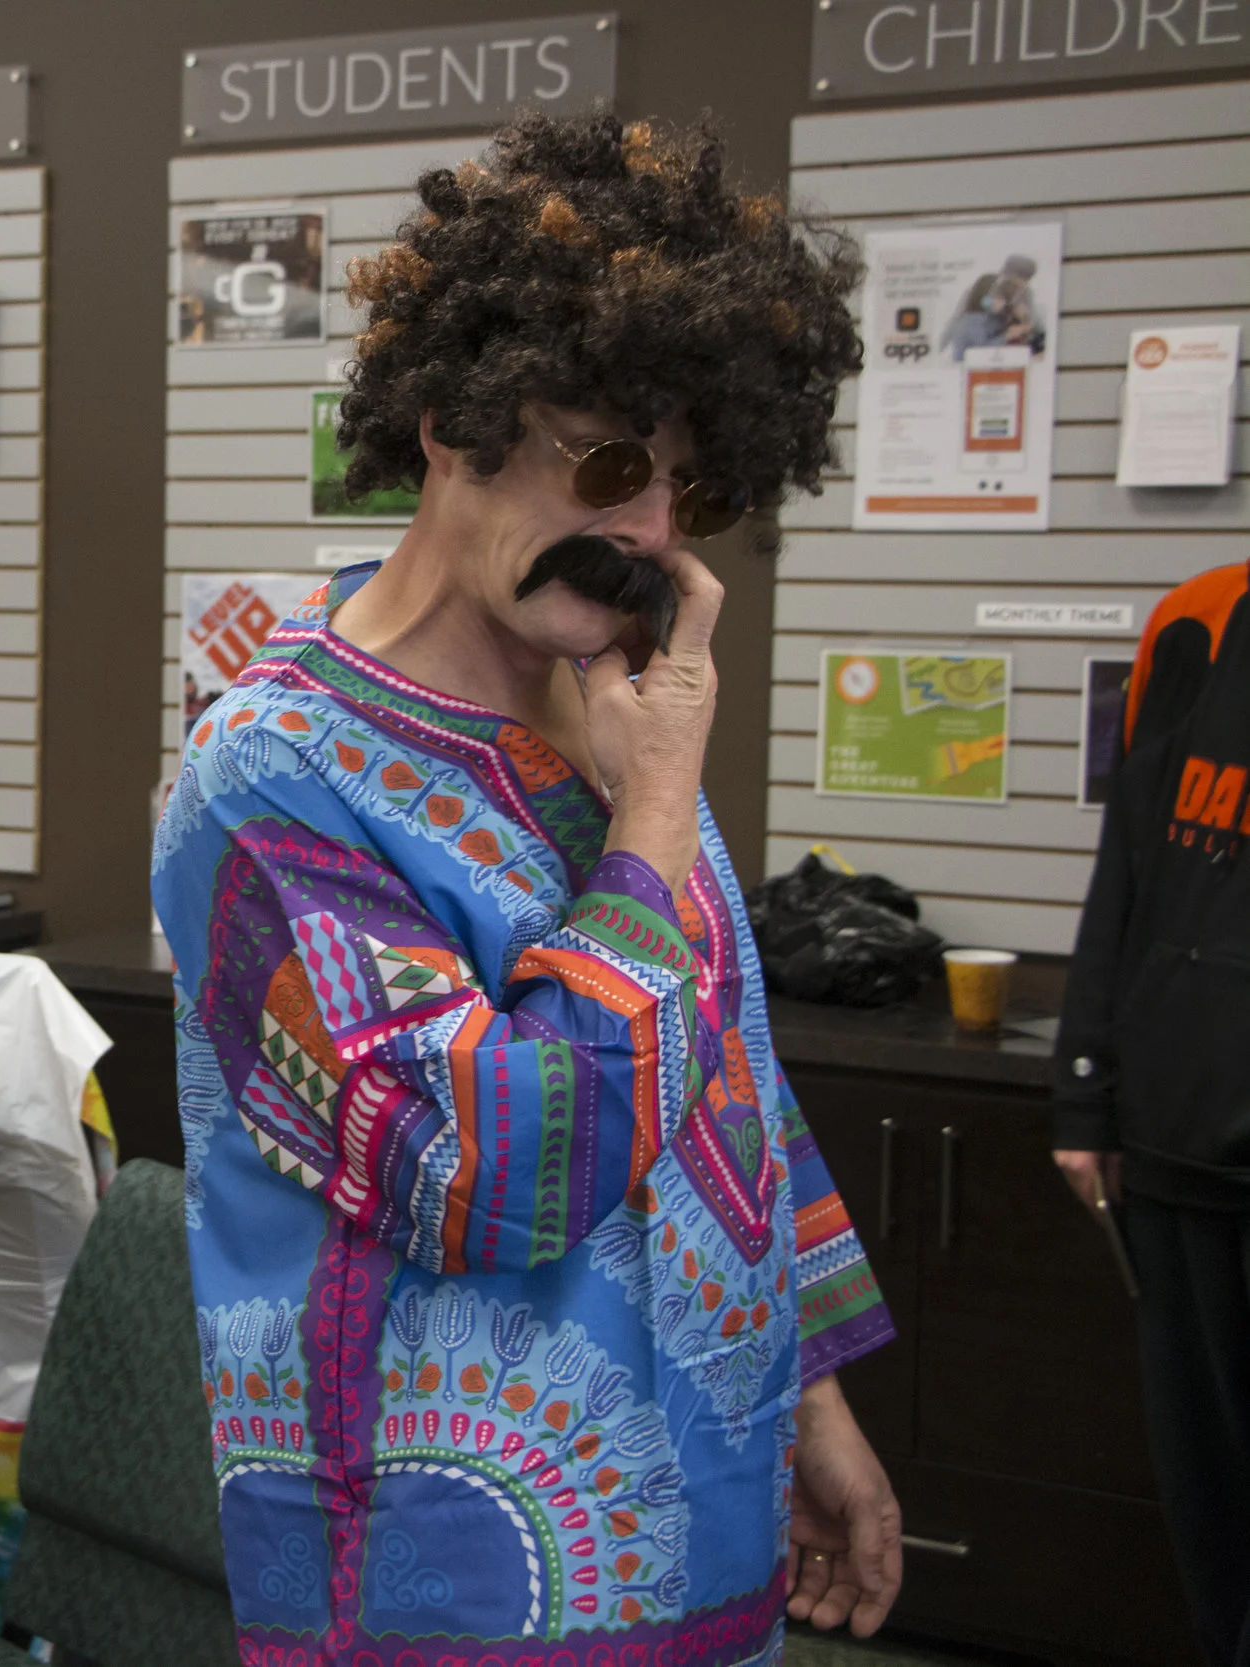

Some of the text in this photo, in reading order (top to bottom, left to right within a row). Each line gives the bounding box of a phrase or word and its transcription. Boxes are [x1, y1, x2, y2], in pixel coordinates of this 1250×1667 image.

[217, 35, 571, 123] STUDENTS
[883, 344, 930, 365] app
[188, 581, 254, 647] LEVEL
[206, 594, 277, 681] UP
[984, 606, 1123, 625] MONTHLY THEME
[1174, 755, 1250, 836] DA
